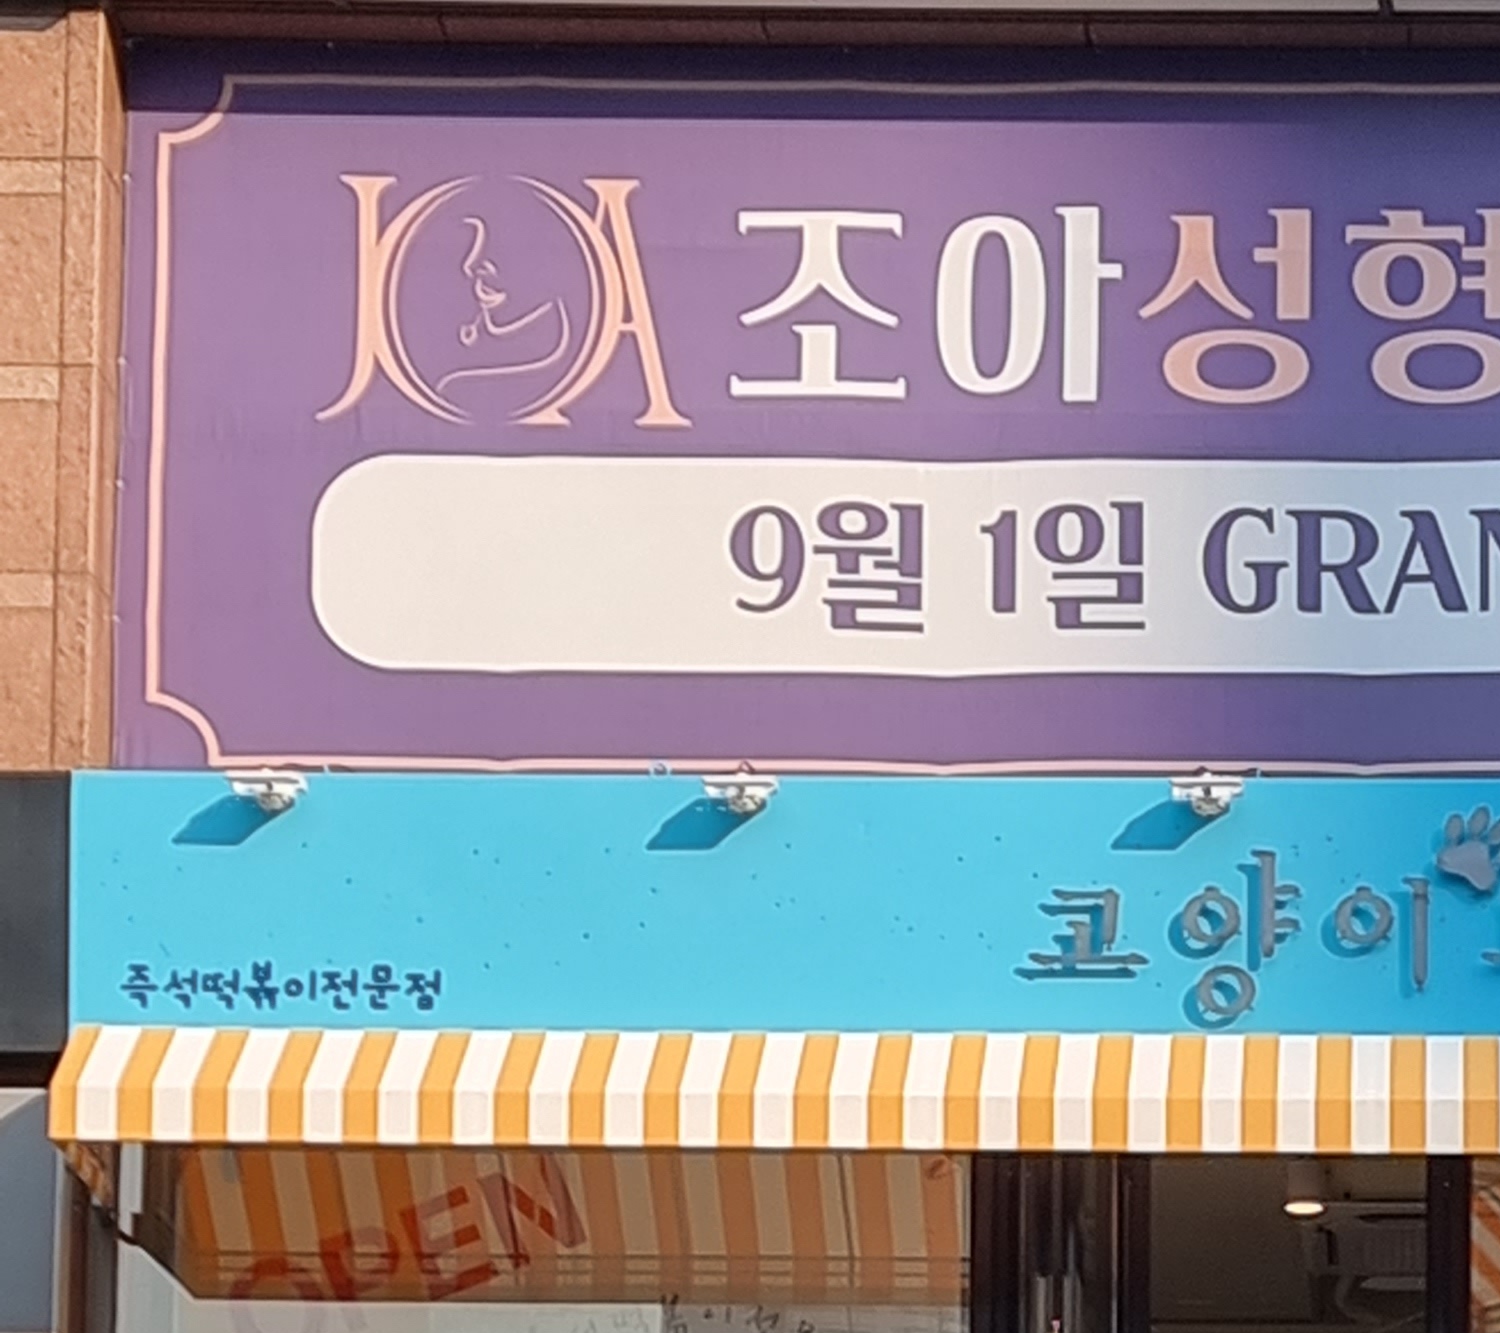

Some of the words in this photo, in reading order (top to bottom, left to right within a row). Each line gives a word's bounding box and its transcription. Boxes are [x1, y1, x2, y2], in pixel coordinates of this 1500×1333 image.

[728, 500, 925, 634] 9월
[979, 500, 1148, 632] 1일
[119, 960, 443, 1011] 즉석떡볶이전문점
